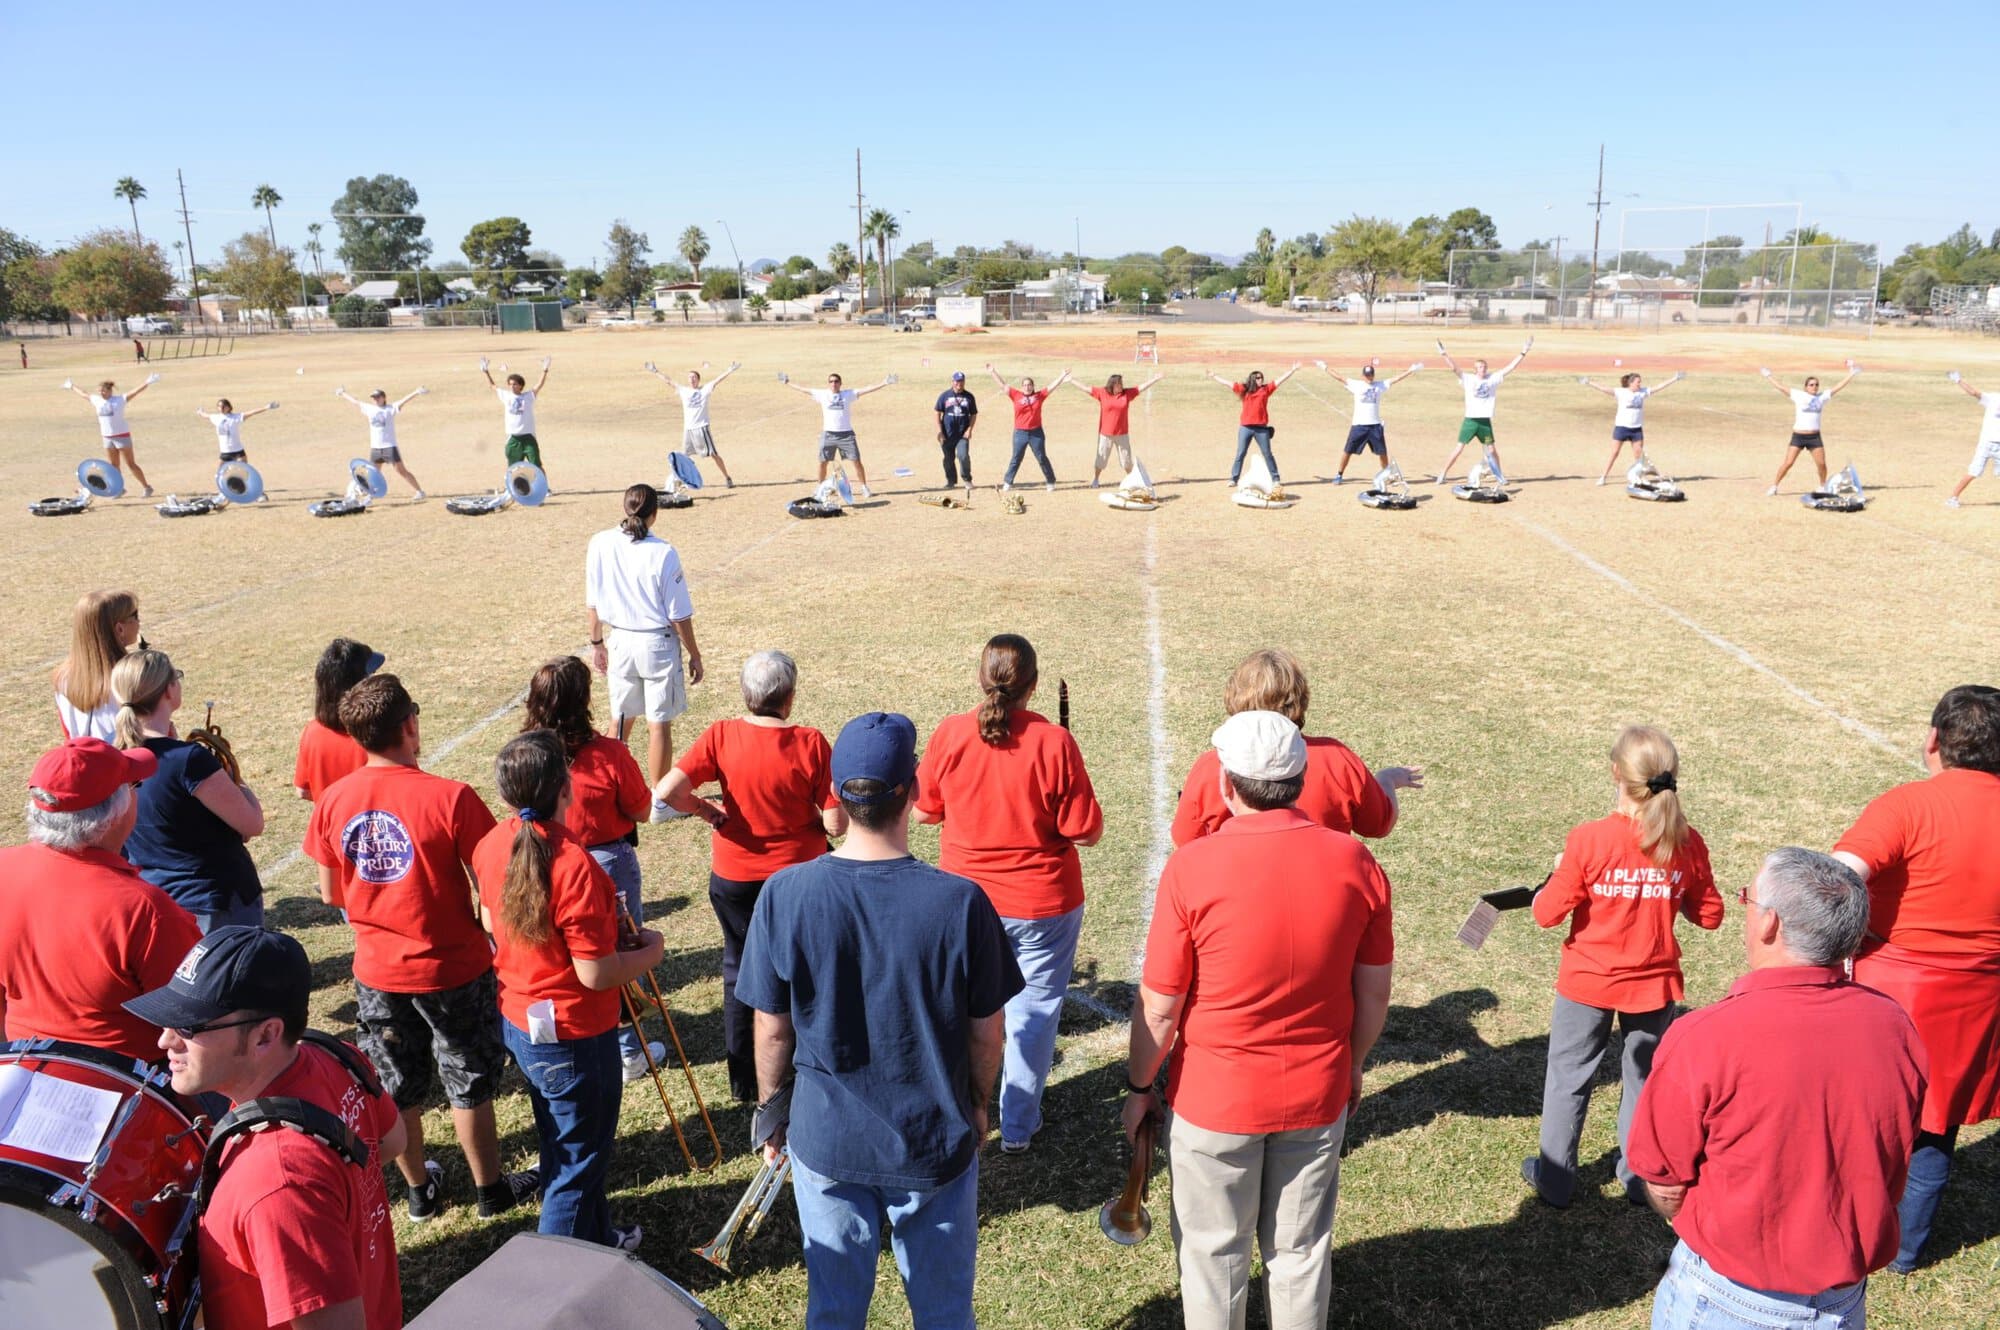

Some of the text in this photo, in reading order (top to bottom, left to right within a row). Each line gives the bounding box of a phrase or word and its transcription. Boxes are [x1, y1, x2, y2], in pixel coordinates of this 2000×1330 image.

[349, 839, 409, 853] CENTURY
[359, 857, 404, 872] PRIDE
[1605, 869, 1611, 883] I
[1613, 867, 1667, 883] PLAYED
[1593, 883, 1640, 899] SUPER
[1641, 883, 1671, 899] BOW
